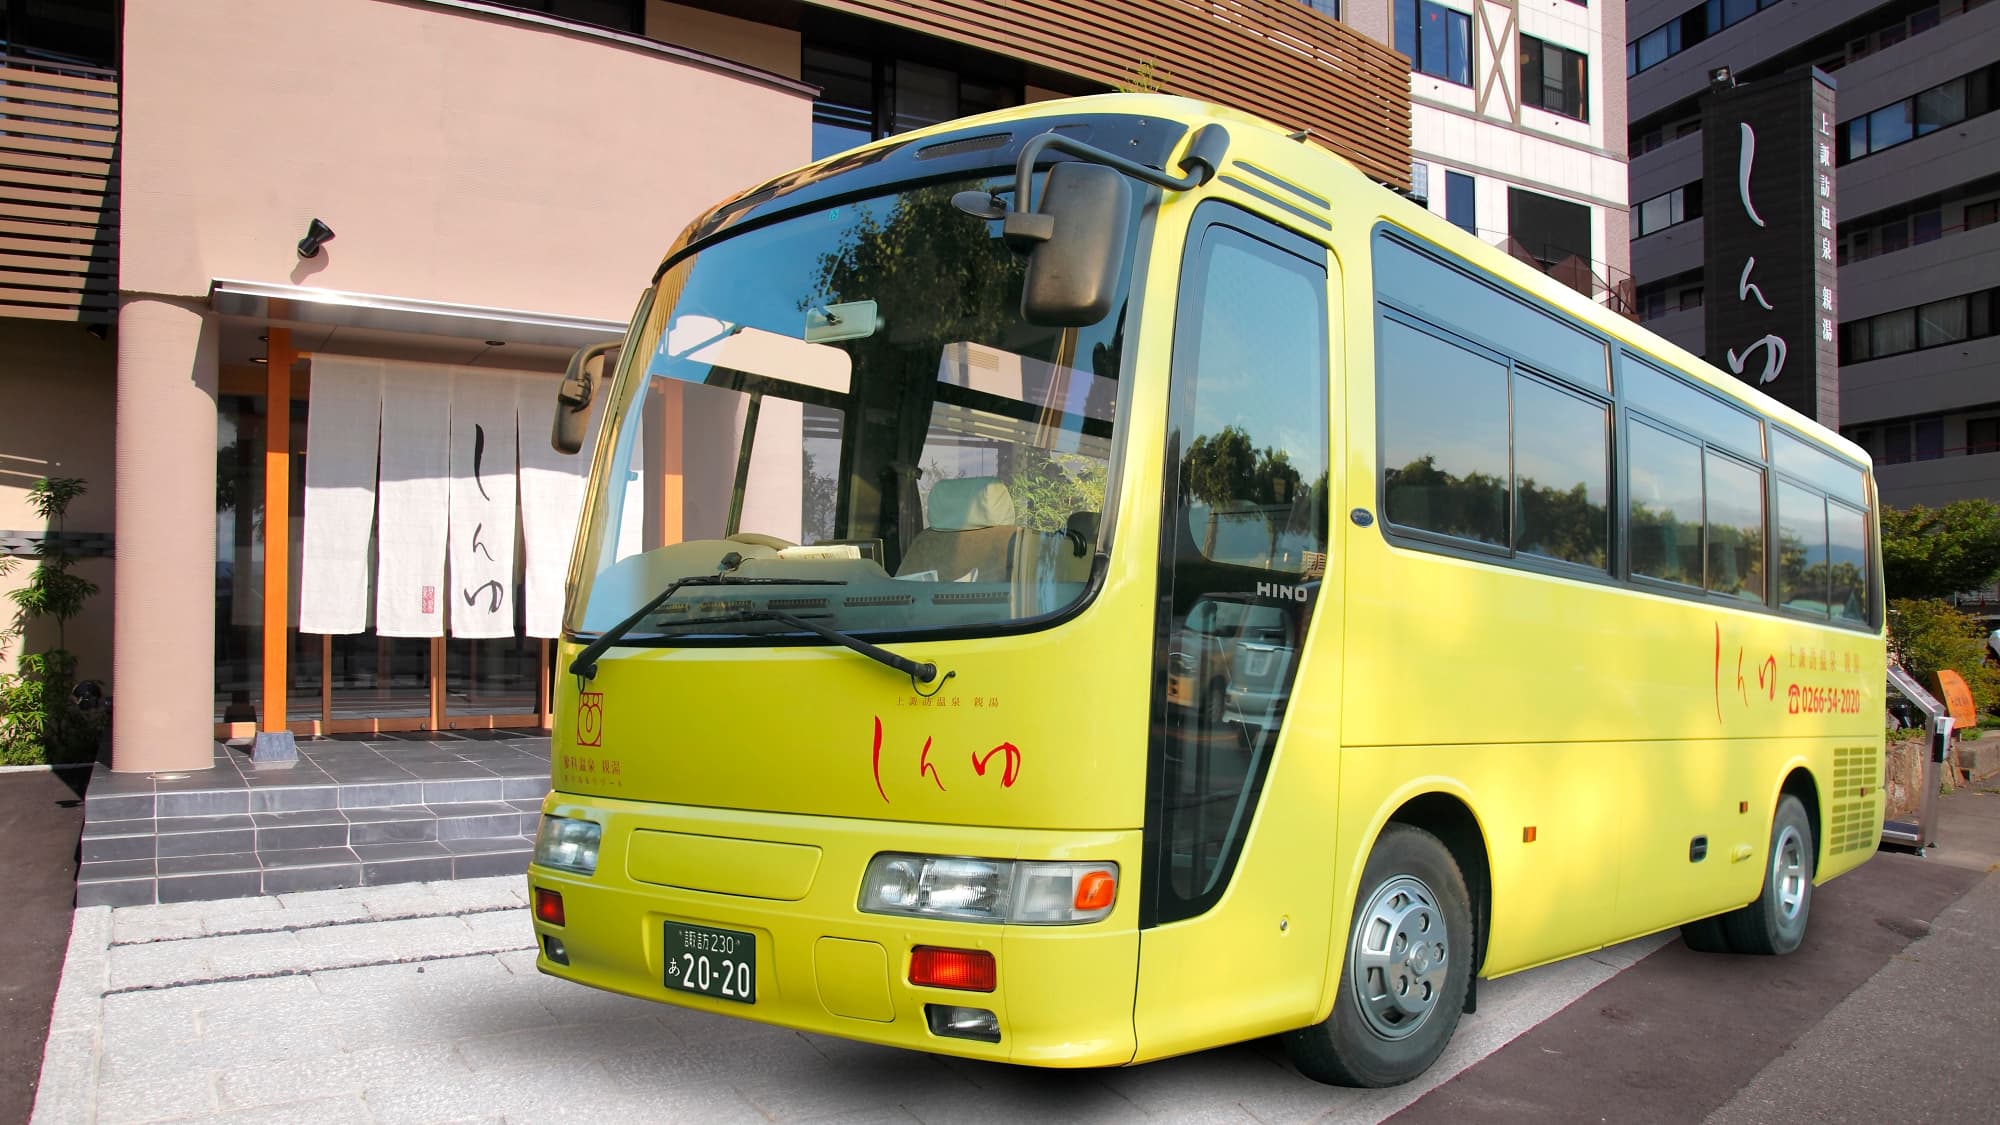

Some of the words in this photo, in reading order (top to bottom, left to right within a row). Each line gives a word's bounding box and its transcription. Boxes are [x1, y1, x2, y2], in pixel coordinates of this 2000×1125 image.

[1819, 113, 1832, 260] 上諏訪温泉
[1726, 122, 1787, 386] しんゆ
[463, 423, 504, 615] しんゆ
[1256, 581, 1308, 602] HINO
[1714, 620, 1777, 725] しんゆ
[1802, 686, 1861, 714] 0266-54-2020
[872, 714, 1022, 804] しんゆ
[668, 957, 681, 977] あ
[682, 952, 751, 998] 20-20
